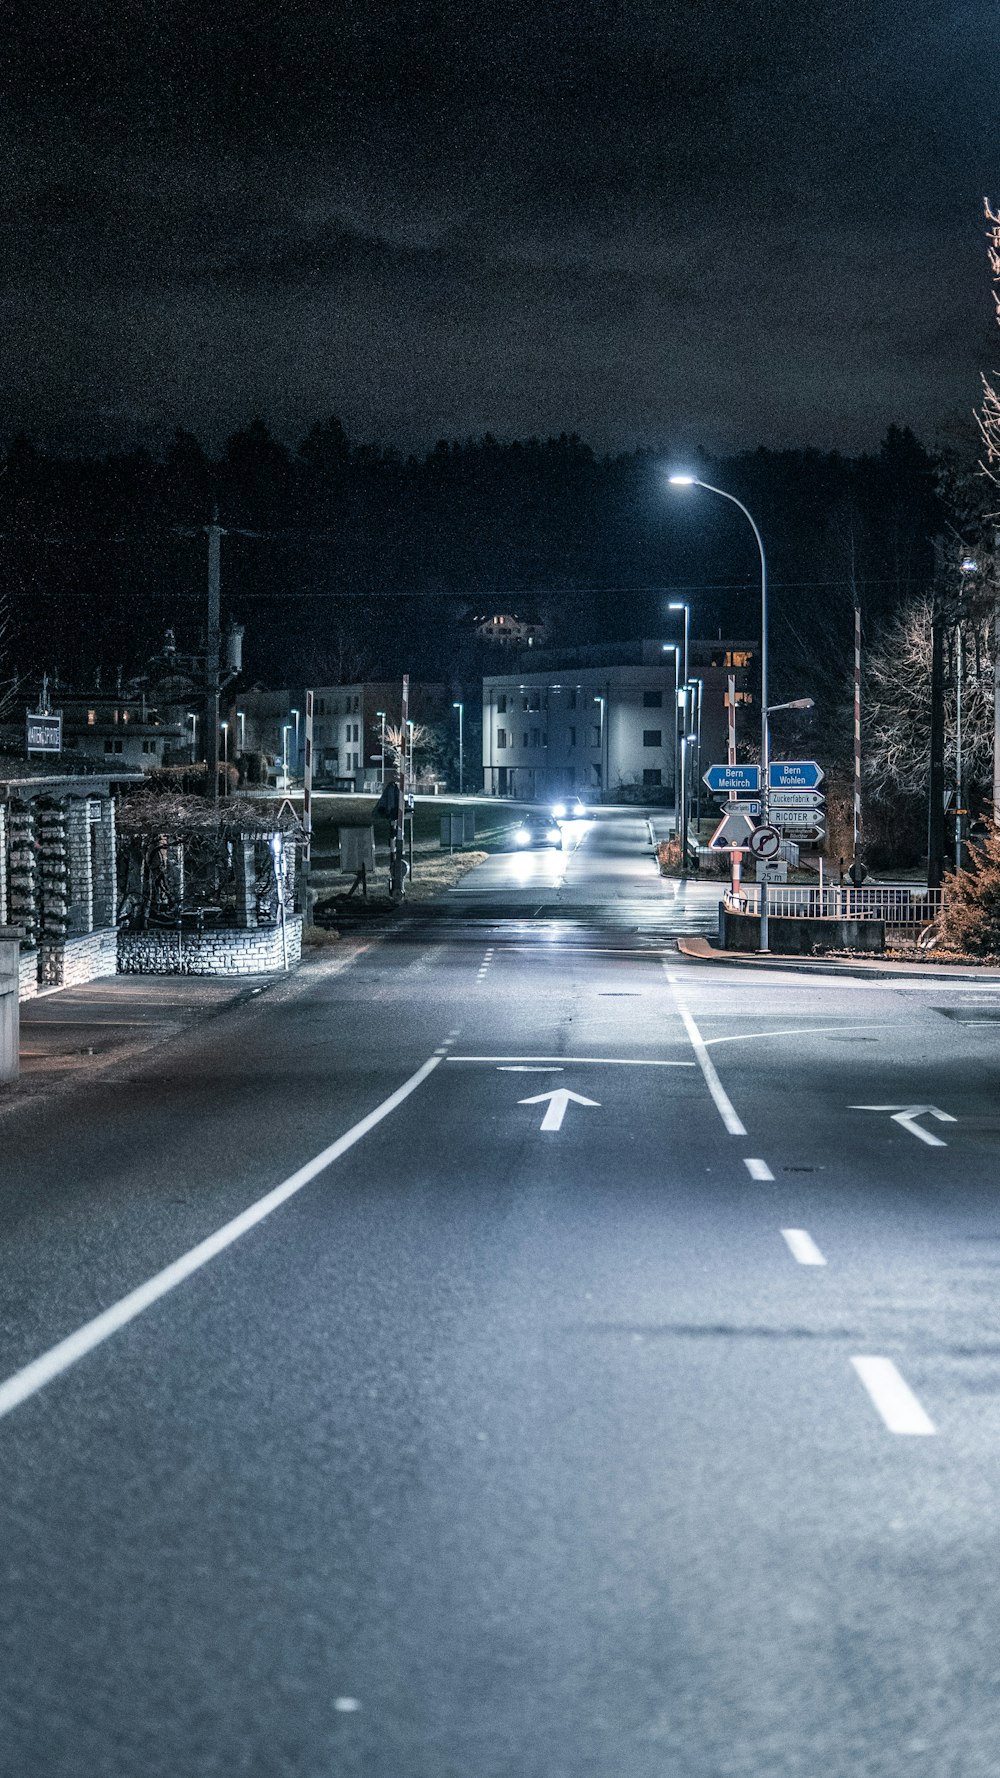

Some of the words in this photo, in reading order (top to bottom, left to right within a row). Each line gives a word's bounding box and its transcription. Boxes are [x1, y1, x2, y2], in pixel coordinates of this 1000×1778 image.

[726, 769, 744, 778] Bern
[783, 766, 801, 775] Bern
[719, 778, 750, 787] Meikirch
[779, 776, 806, 785] Wohlen
[773, 794, 809, 803] Zuckerfabrik
[775, 813, 808, 821] RICOTER
[761, 872, 771, 881] 25
